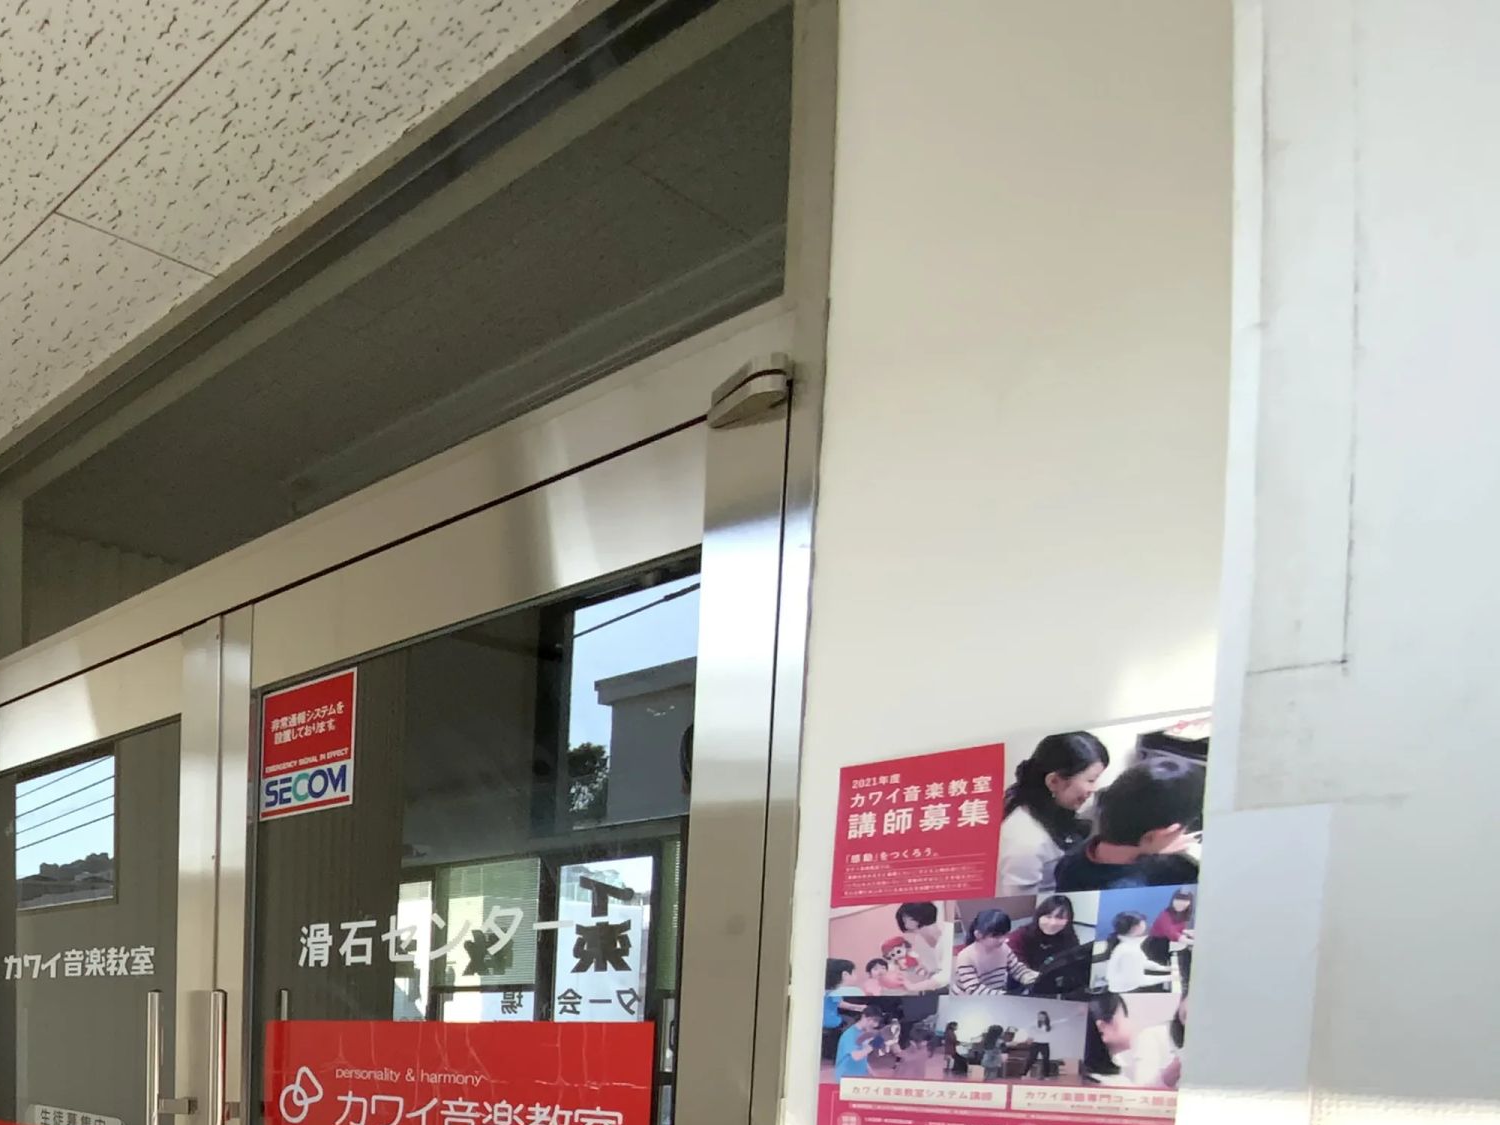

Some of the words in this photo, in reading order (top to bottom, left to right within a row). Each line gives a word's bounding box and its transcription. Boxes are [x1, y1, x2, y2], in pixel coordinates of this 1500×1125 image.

[265, 764, 347, 808] SECOM
[850, 776, 992, 808] カワイ音楽教室
[852, 773, 901, 790] 2021年度
[847, 799, 990, 840] 講師募集
[298, 905, 574, 968] 滑石センター
[4, 945, 155, 980] カワイ音楽教室
[335, 1068, 401, 1083] personality
[405, 1068, 415, 1082] &
[420, 1070, 482, 1087] harmony
